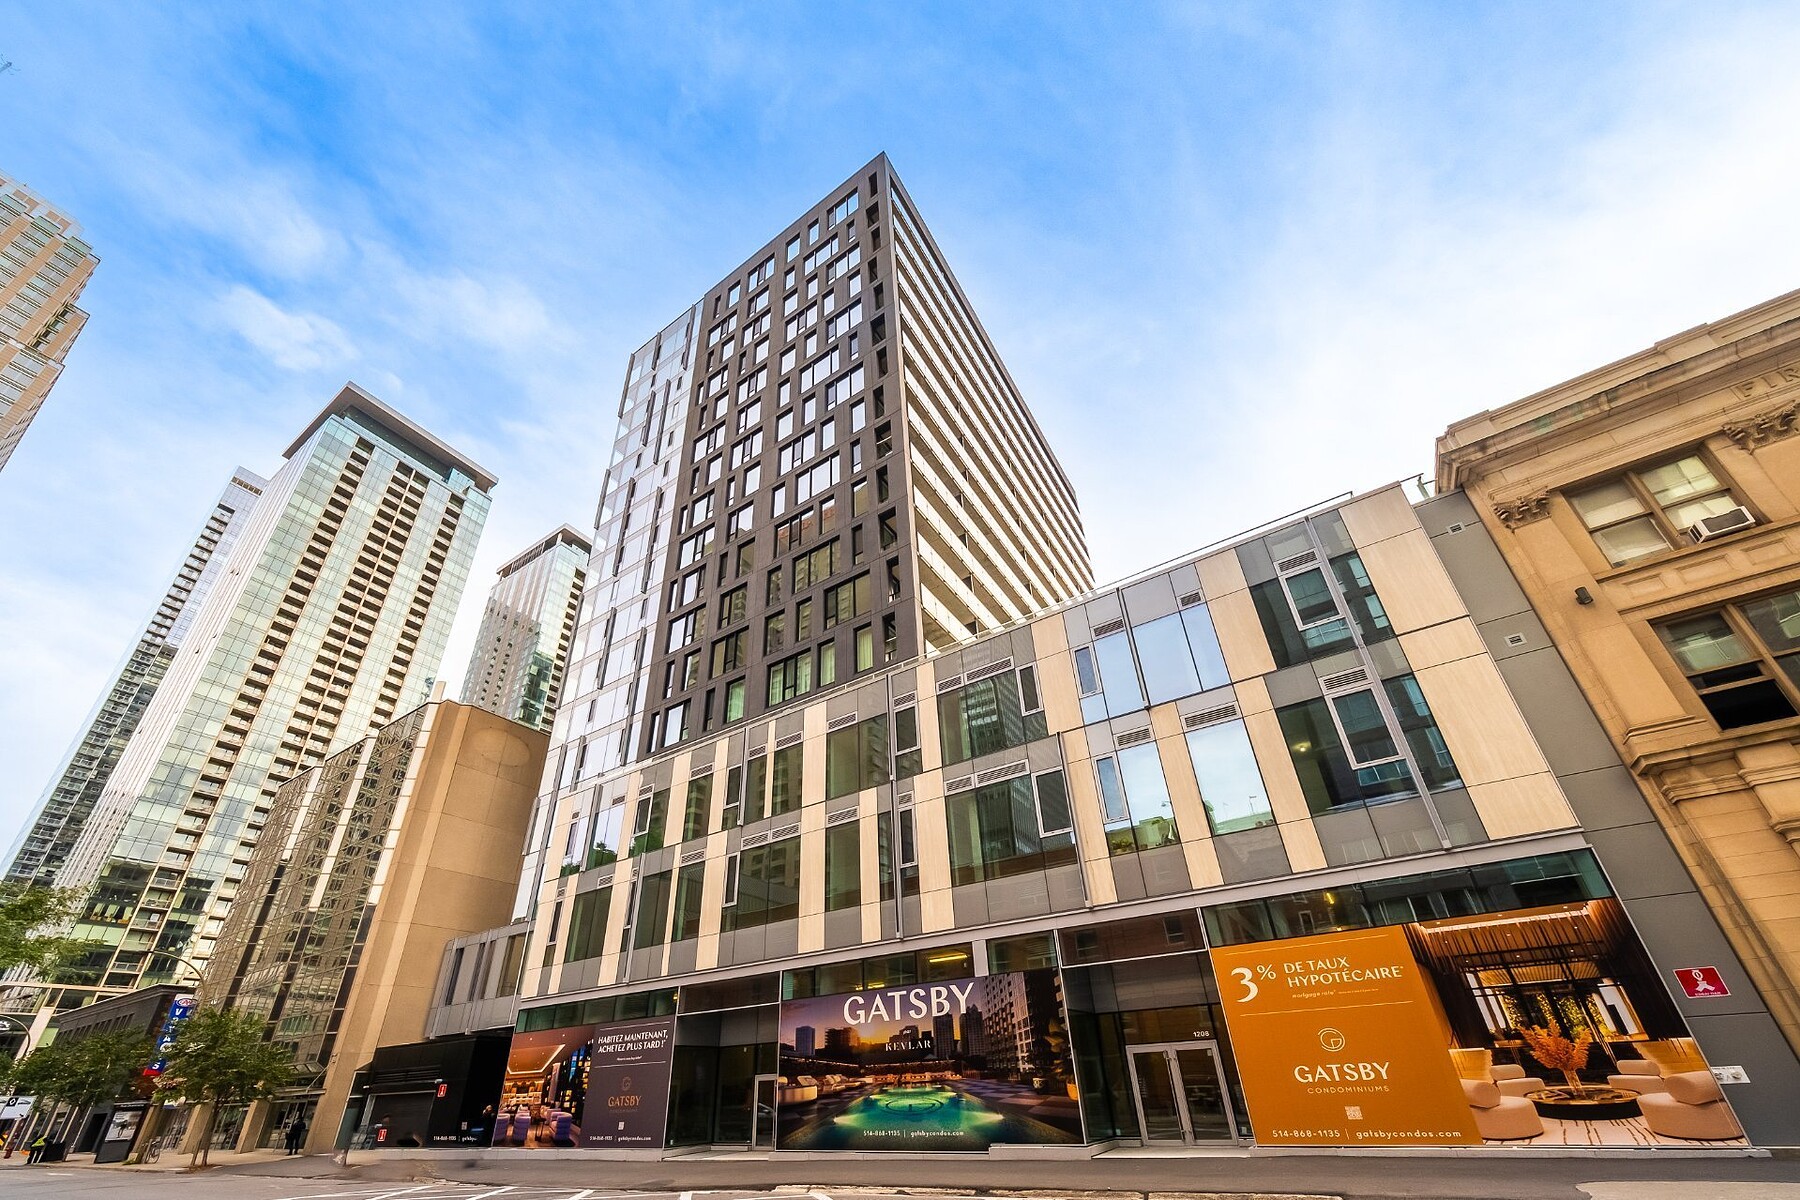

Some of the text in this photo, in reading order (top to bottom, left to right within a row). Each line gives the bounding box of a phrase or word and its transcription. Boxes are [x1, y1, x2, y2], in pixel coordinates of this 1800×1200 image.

[1284, 956, 1350, 974] DE TAUX
[843, 982, 975, 1025] GATSBY
[598, 1034, 624, 1044] HABITEZ
[597, 1043, 626, 1054] ACHETEZ
[626, 1041, 643, 1051] PLUS
[643, 1040, 660, 1049] TARD
[885, 1040, 931, 1051] KEVLAR
[1294, 1061, 1390, 1083] GATSBY
[1307, 1084, 1390, 1094] CONDOMINIUMS
[607, 1095, 641, 1107] GATSBY
[1272, 1128, 1462, 1140] 514-868-1135 gatsbycondos.com
